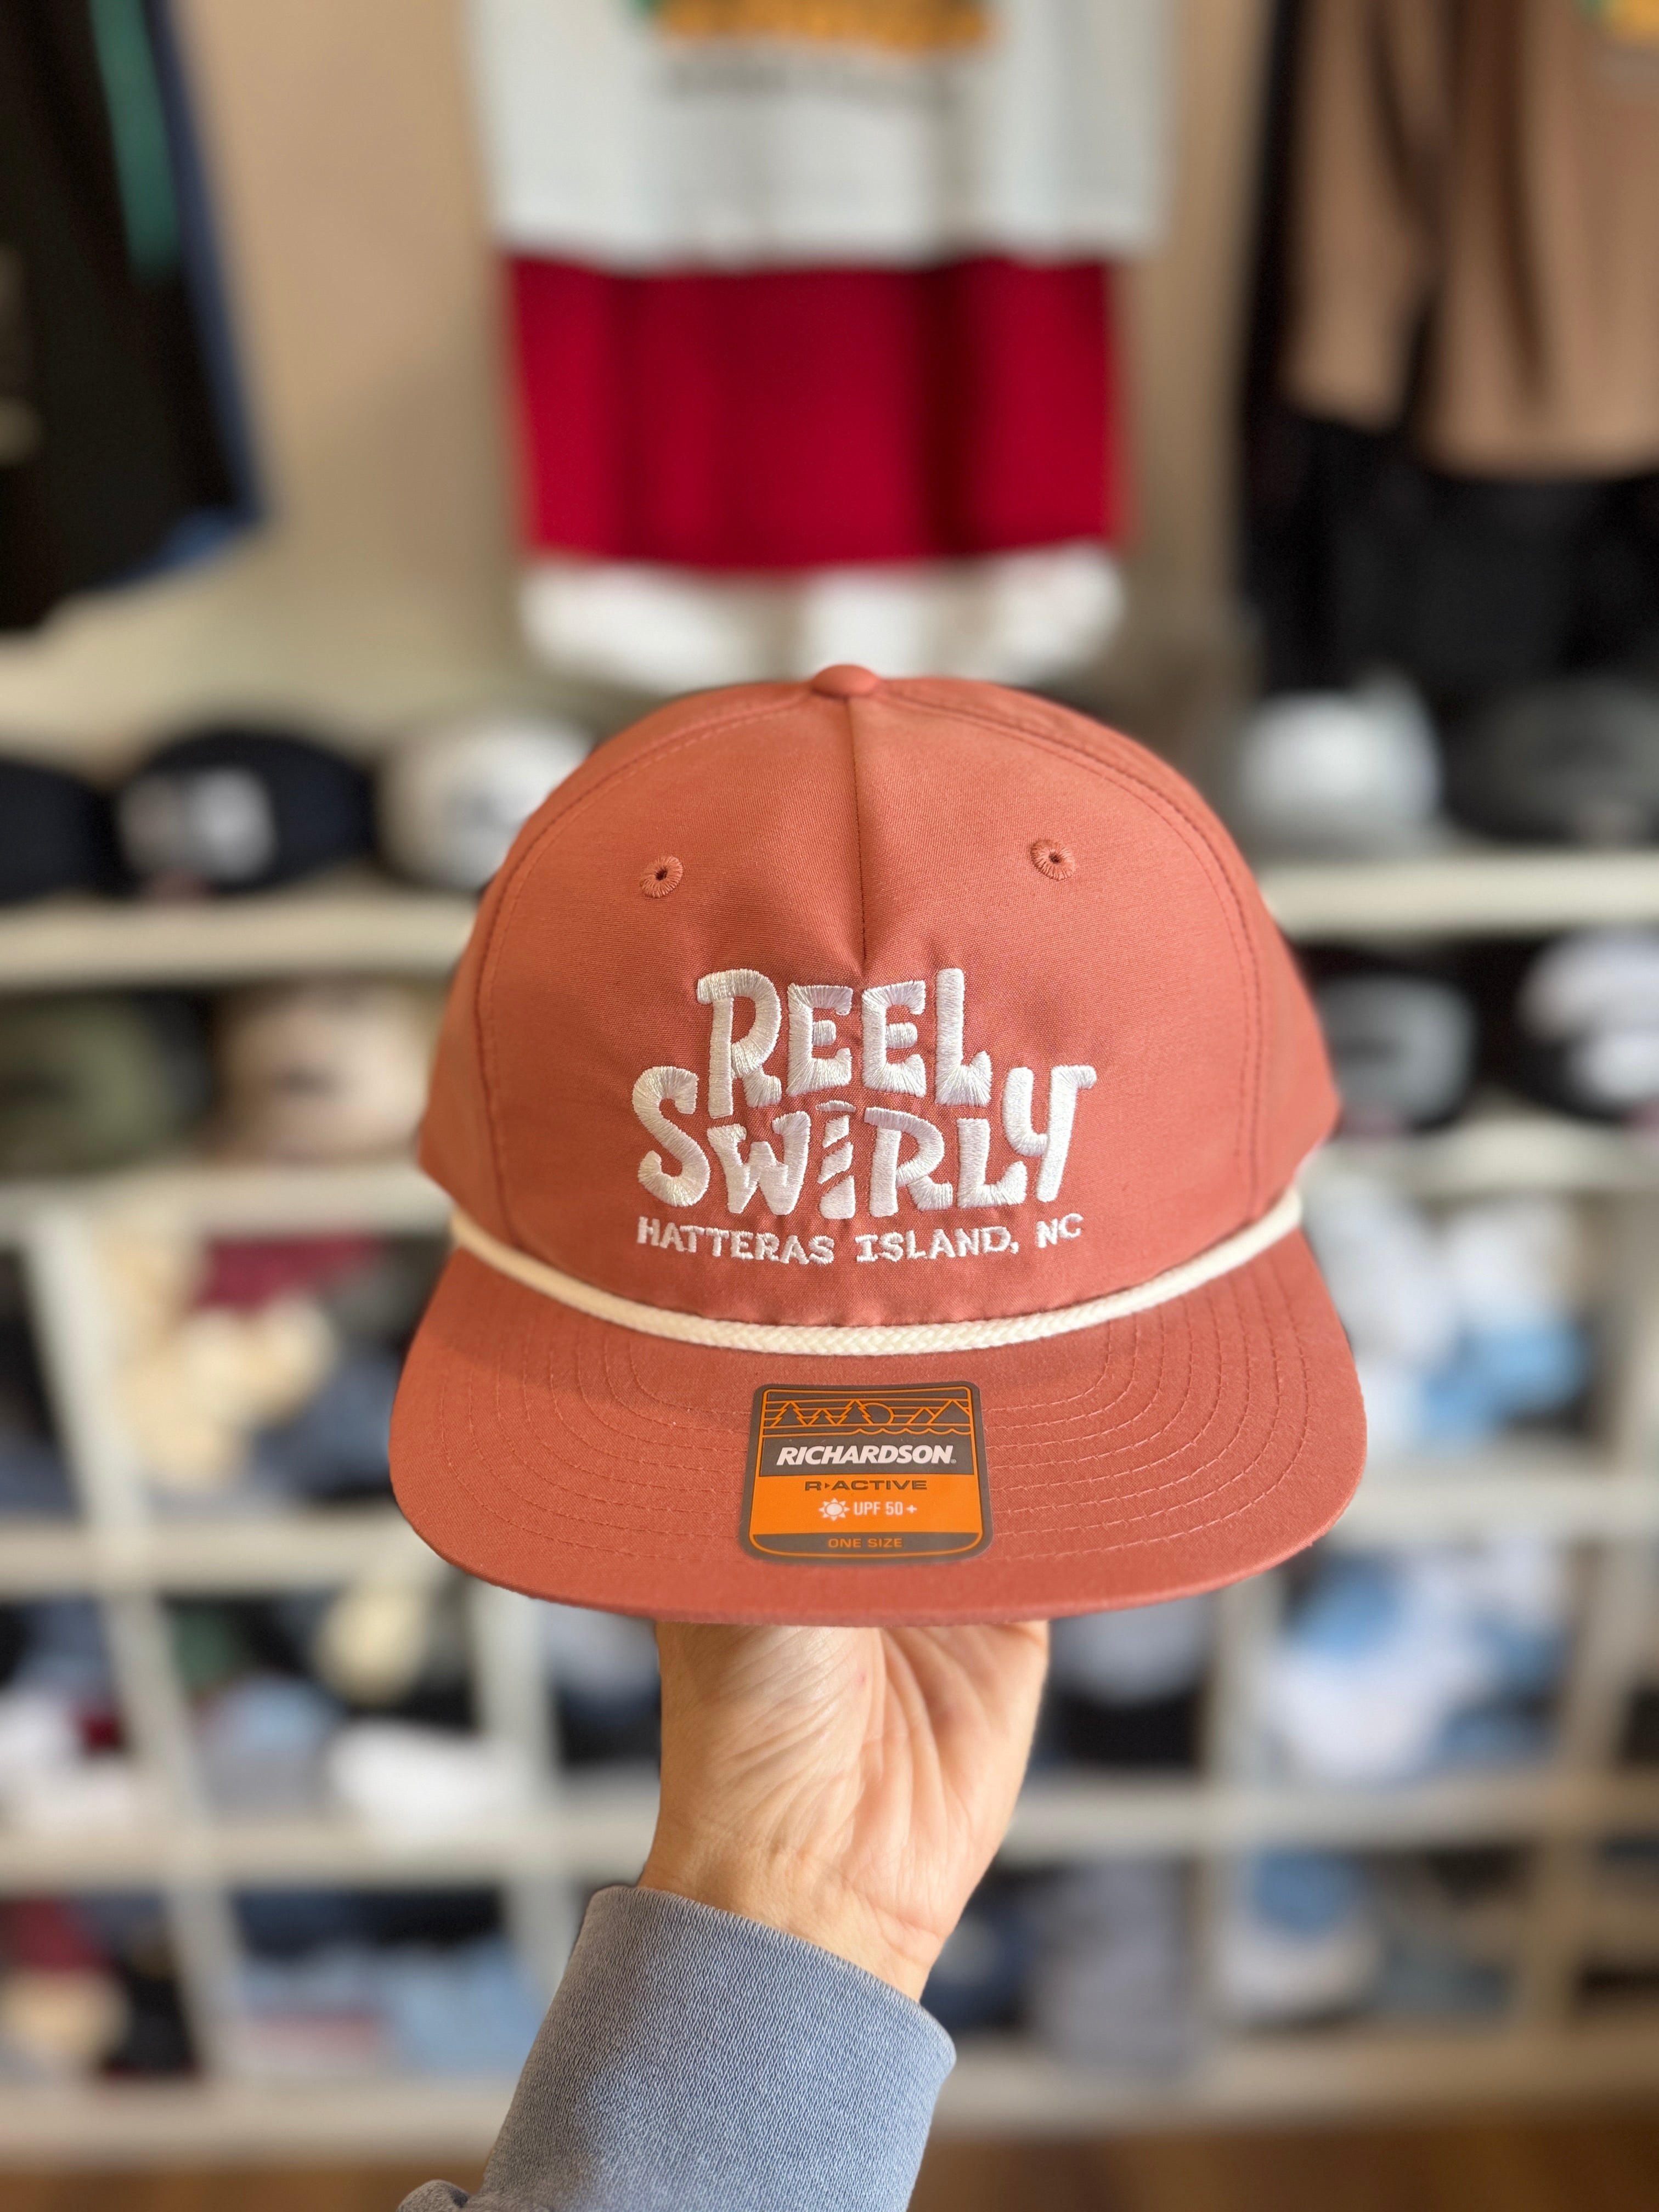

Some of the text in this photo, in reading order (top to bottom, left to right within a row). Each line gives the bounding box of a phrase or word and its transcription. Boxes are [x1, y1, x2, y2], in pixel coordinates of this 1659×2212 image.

[697, 968, 992, 1119] REEL
[632, 1065, 1097, 1220] SWIRLY
[636, 1213, 1084, 1265] HATTERAS ISLAND, NC
[776, 1445, 953, 1466] RICHARDSON
[854, 1502, 881, 1515] UPF
[828, 1538, 902, 1548] ONE SIZE
